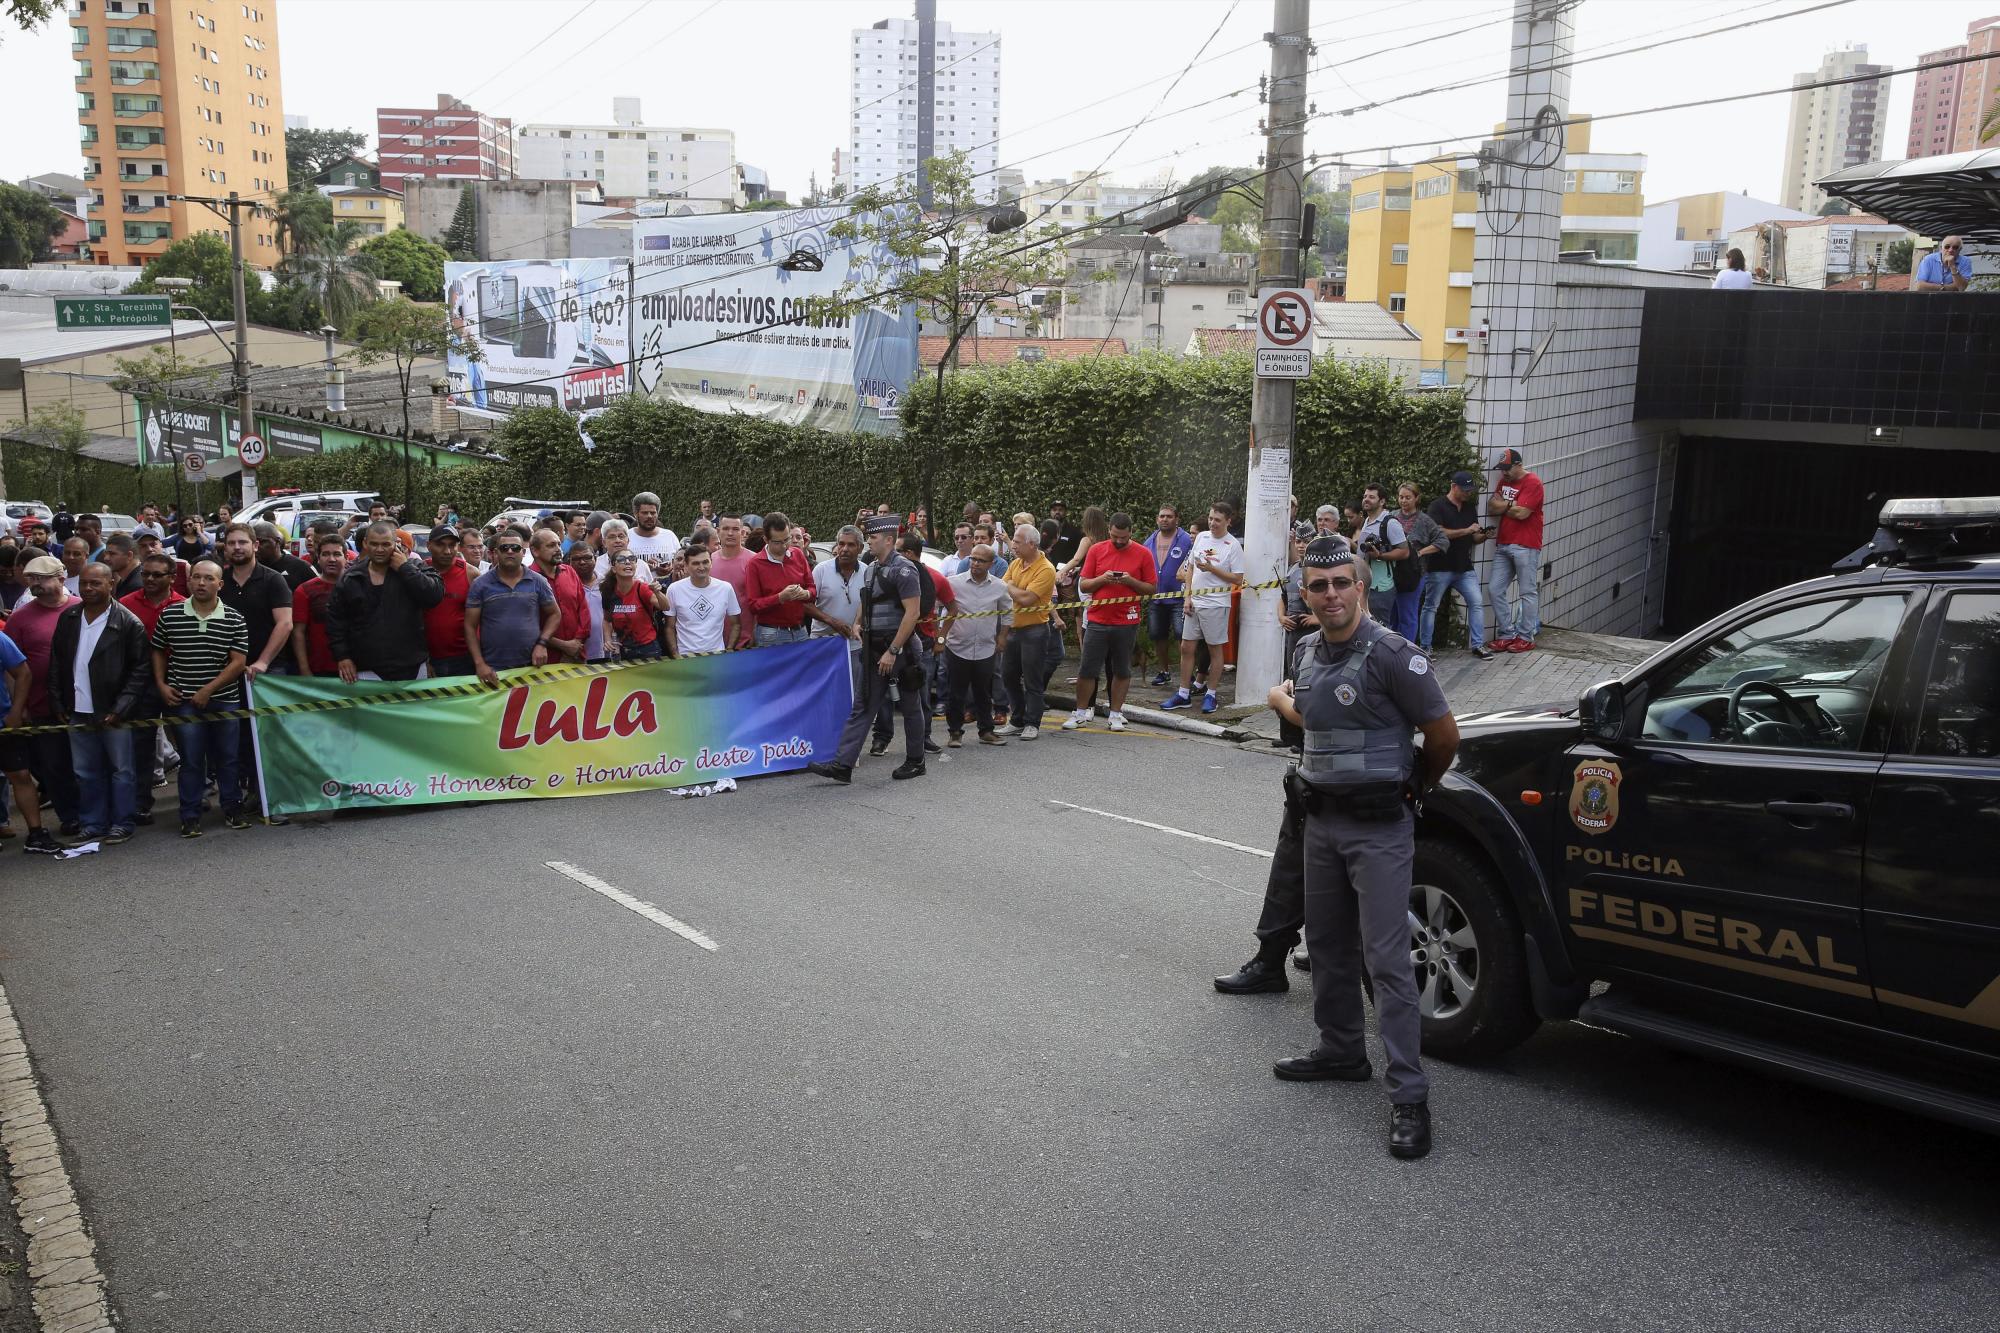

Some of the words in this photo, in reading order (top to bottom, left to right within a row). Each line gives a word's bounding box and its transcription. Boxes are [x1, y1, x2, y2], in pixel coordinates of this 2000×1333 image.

[672, 236, 691, 248] ACABA
[692, 235, 700, 248] DE
[701, 235, 723, 250] LANÇAR
[724, 234, 737, 247] SUA
[639, 255, 653, 267] LOJA
[655, 254, 675, 266] ONLINE
[676, 254, 685, 266] DE
[686, 253, 713, 266] ADESIVOS
[715, 252, 755, 265] DECORATIVOS.
[78, 303, 89, 312] V.
[94, 303, 114, 312] Sta.
[119, 303, 163, 311] Terezinha
[560, 292, 578, 322] de
[79, 315, 89, 323] B.
[94, 315, 105, 323] N.
[110, 314, 158, 323] Petrópolis
[764, 332, 785, 345] estiver
[787, 333, 810, 347] através
[811, 334, 820, 347] de
[821, 337, 832, 348] um
[832, 336, 852, 349] click.
[1260, 352, 1308, 362] CAMINHÕES
[1272, 362, 1303, 372] ÔNIBUS
[184, 413, 210, 432] SOCIETY
[242, 440, 262, 454] 40
[322, 779, 341, 797] O
[351, 778, 417, 798] mais
[429, 773, 536, 796] Honesto
[547, 773, 564, 788] e
[575, 754, 686, 786] Honrado
[696, 745, 754, 770] deste
[1577, 815, 1608, 828] FEDERAL
[1568, 888, 1858, 975] FEDERAL
